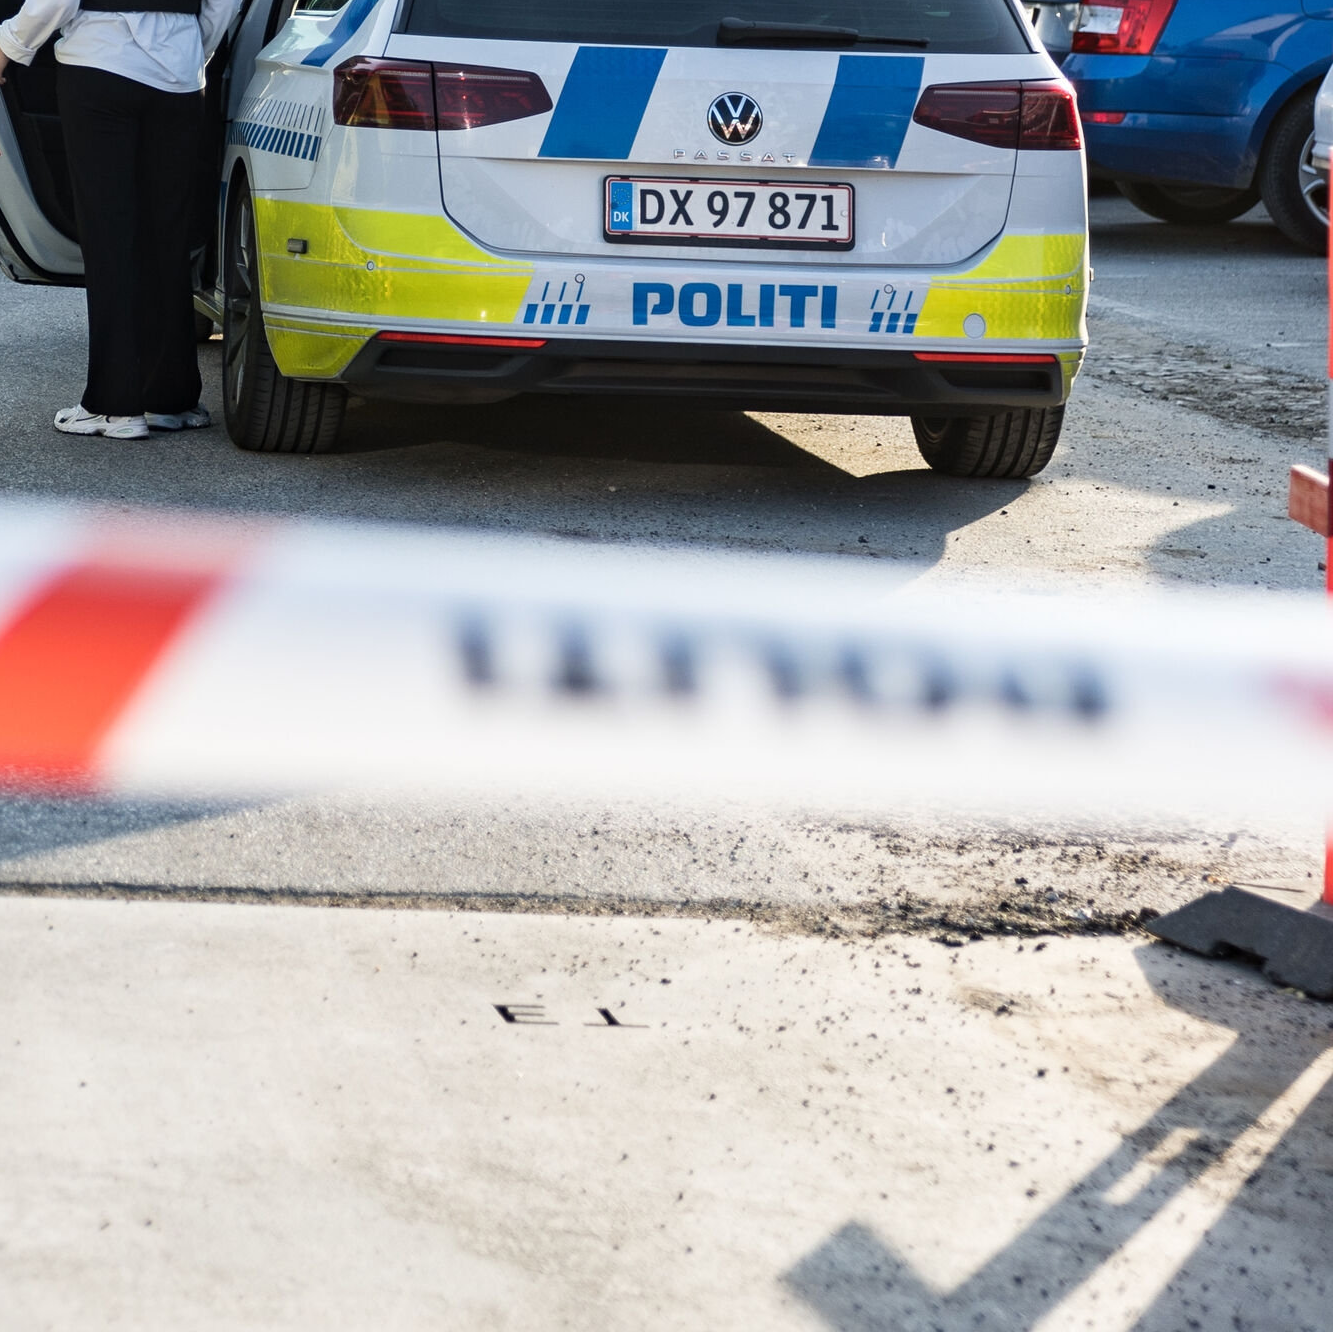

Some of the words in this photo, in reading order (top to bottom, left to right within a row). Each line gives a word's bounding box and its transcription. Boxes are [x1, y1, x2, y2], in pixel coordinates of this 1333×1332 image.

[674, 149, 795, 163] PASSAT
[613, 211, 630, 223] DK
[639, 189, 694, 226] DX
[707, 190, 756, 229] 97
[768, 192, 840, 231] 871
[633, 282, 838, 329] POLITI
